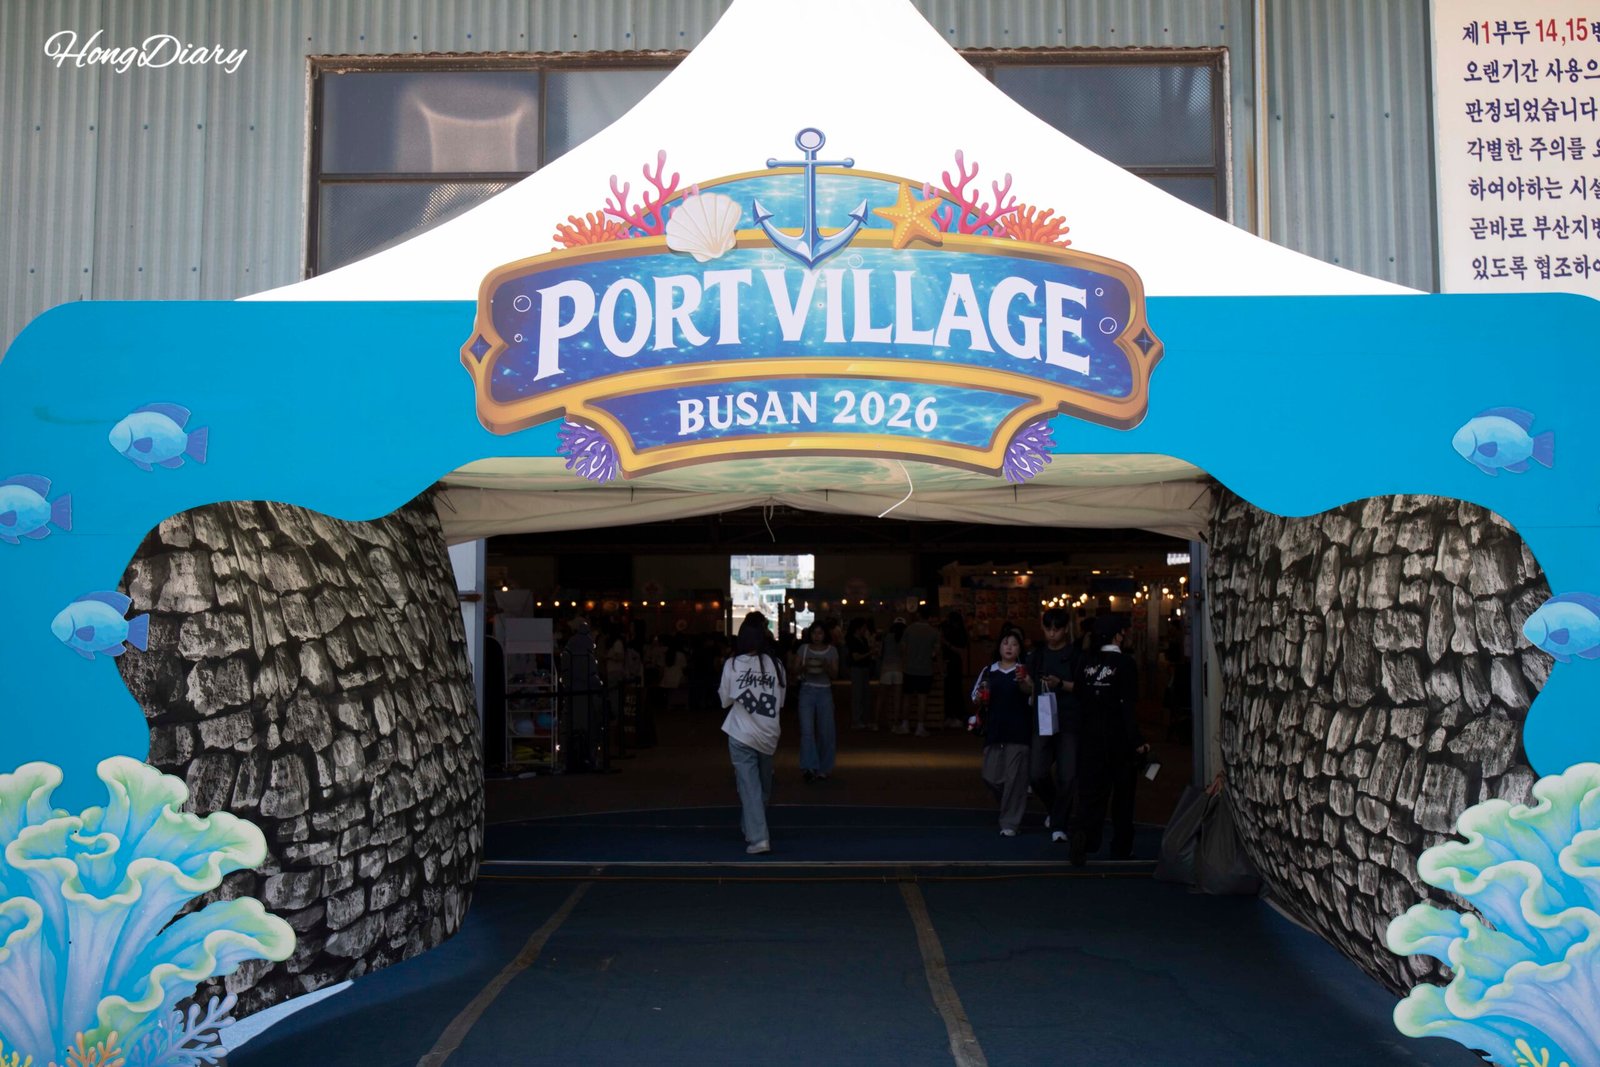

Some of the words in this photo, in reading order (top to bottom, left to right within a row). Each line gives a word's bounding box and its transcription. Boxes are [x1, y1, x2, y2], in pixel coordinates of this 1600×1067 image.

[1462, 20, 1531, 46] 제1부두
[1463, 58, 1539, 84] 오랜기간
[1465, 96, 1599, 124] 판정되었습니다
[1466, 137, 1523, 163] 각별한
[1529, 136, 1586, 162] 주의를
[1468, 175, 1563, 202] 하여야하는
[1469, 215, 1528, 241] 곧바로
[1471, 255, 1529, 281] 있도록
[533, 268, 753, 383] PORT
[760, 267, 1091, 377] VILLAGE
[676, 390, 819, 437] BUSAN
[831, 389, 939, 433] 2026
